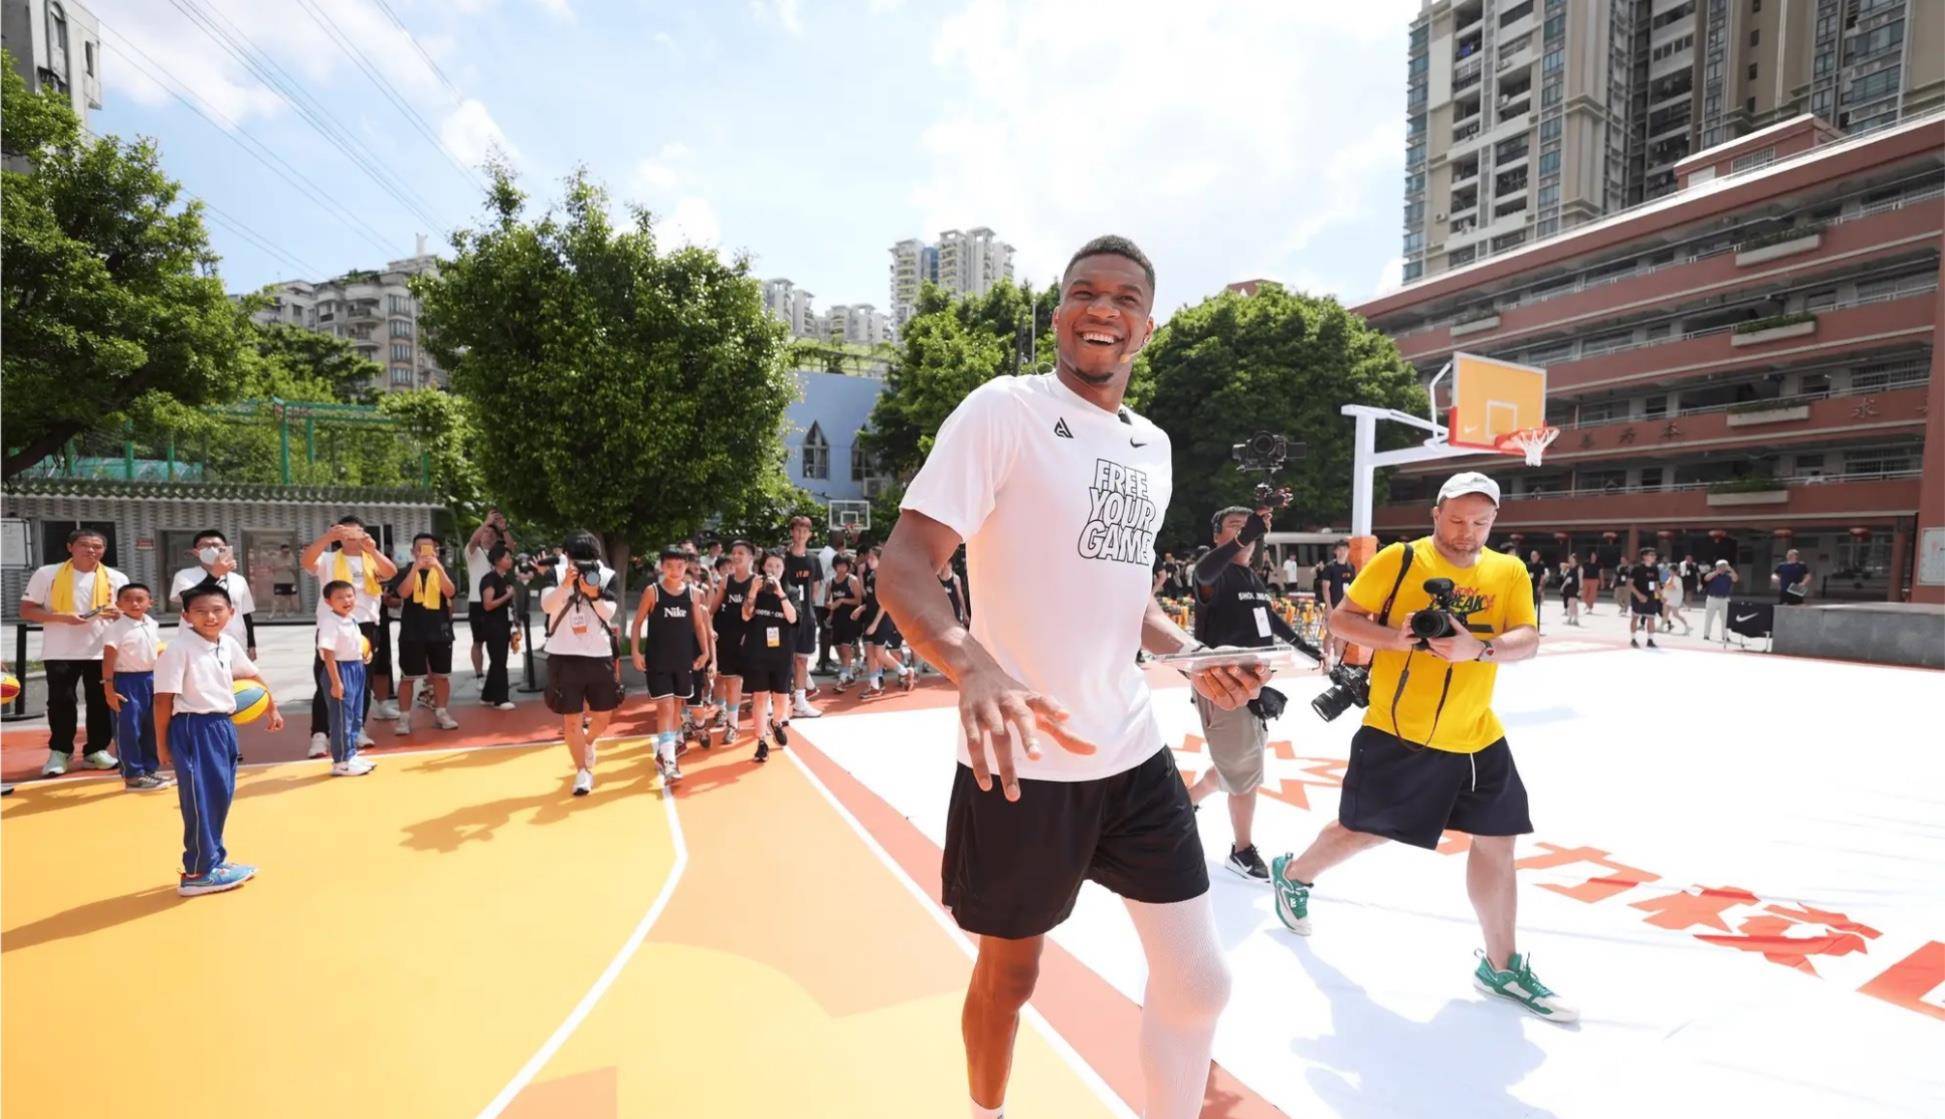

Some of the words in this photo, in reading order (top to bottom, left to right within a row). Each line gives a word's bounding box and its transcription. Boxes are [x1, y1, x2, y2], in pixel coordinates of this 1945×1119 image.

[1093, 458, 1149, 499] FREE
[1089, 487, 1157, 532] YOUR
[1078, 520, 1153, 566] GAME
[663, 606, 687, 618] Nike
